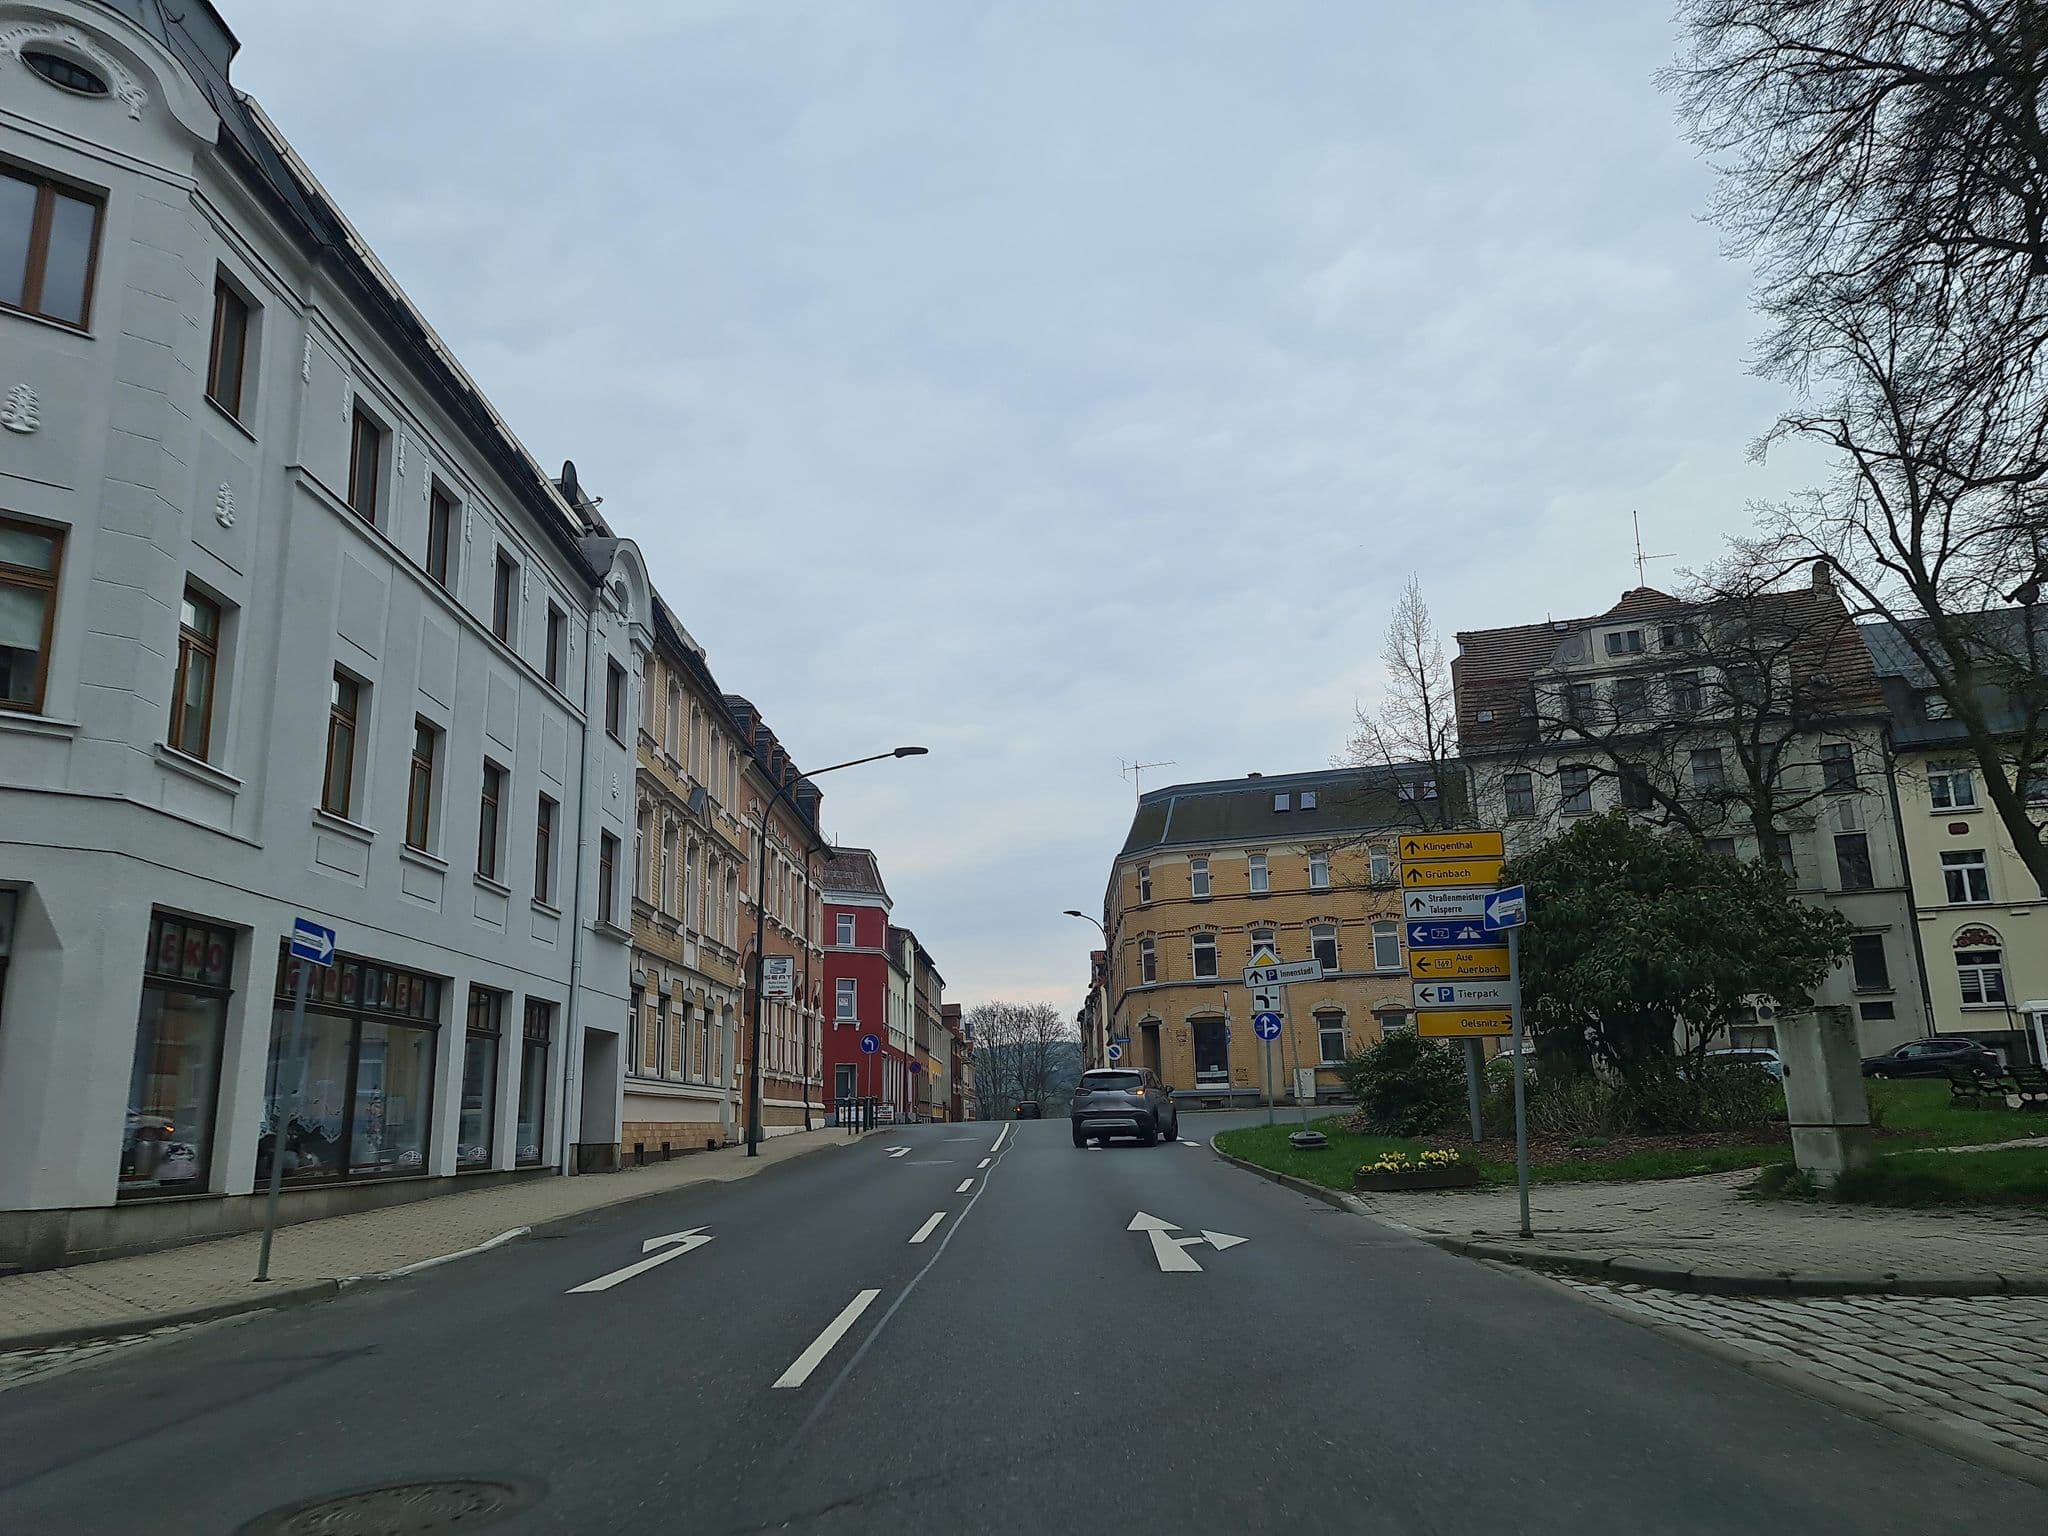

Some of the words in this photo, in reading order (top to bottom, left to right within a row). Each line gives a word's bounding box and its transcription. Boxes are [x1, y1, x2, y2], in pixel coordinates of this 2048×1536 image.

[1423, 840, 1473, 851] Klingenthal
[1425, 869, 1471, 878] Grünbach
[1430, 905, 1463, 915] Talsperre
[1455, 953, 1473, 961] Aue
[1280, 967, 1314, 977] Innenstadt
[1457, 965, 1501, 974] Auerbach
[1457, 989, 1499, 1000] Tierpark
[1461, 1018, 1499, 1028] Oelsnitz
